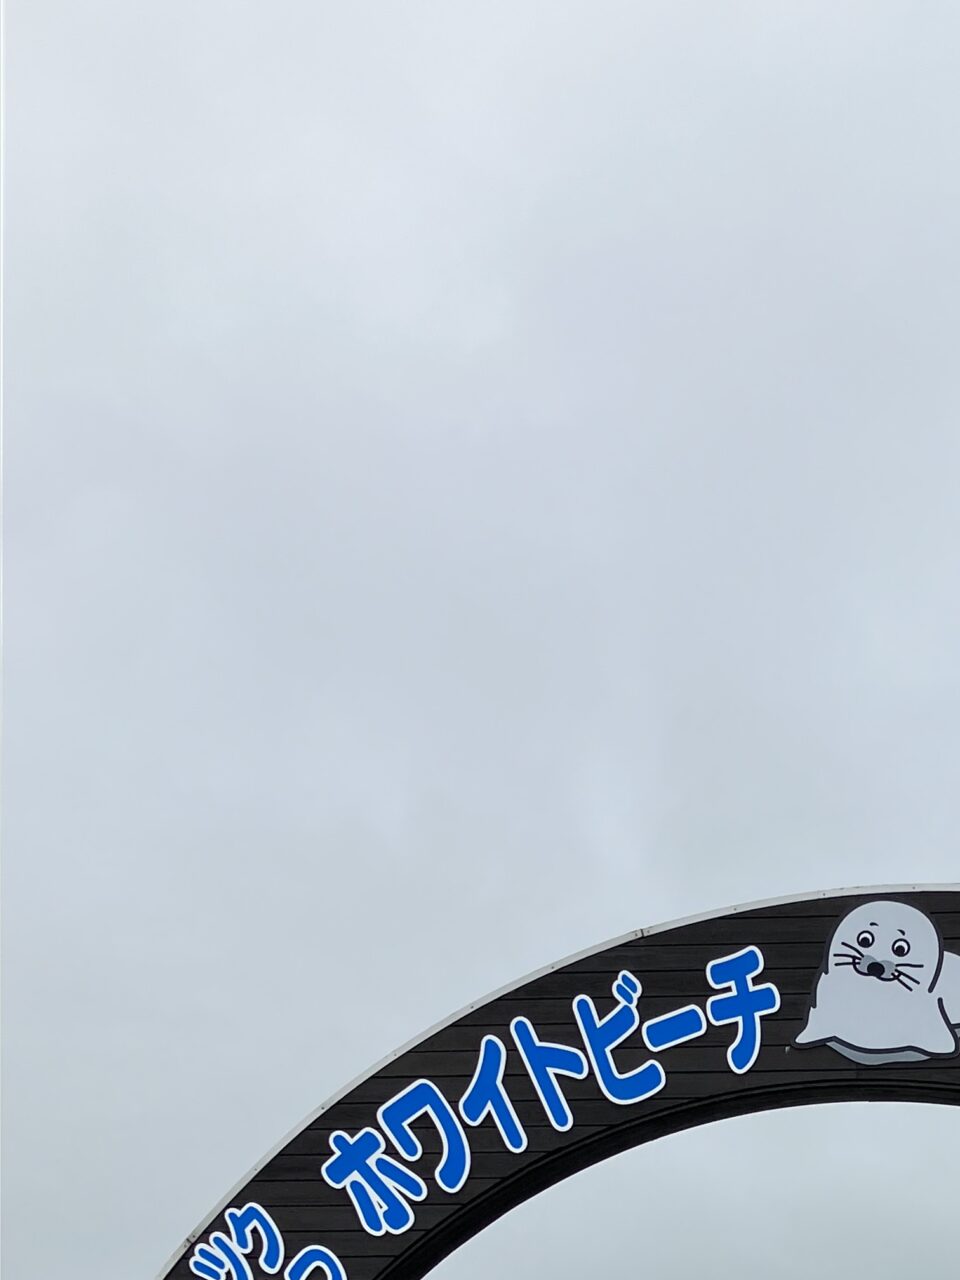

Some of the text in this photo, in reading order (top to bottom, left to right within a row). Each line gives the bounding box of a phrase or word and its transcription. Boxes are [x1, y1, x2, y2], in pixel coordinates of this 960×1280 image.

[323, 948, 778, 1234] ホワイトビーチ
